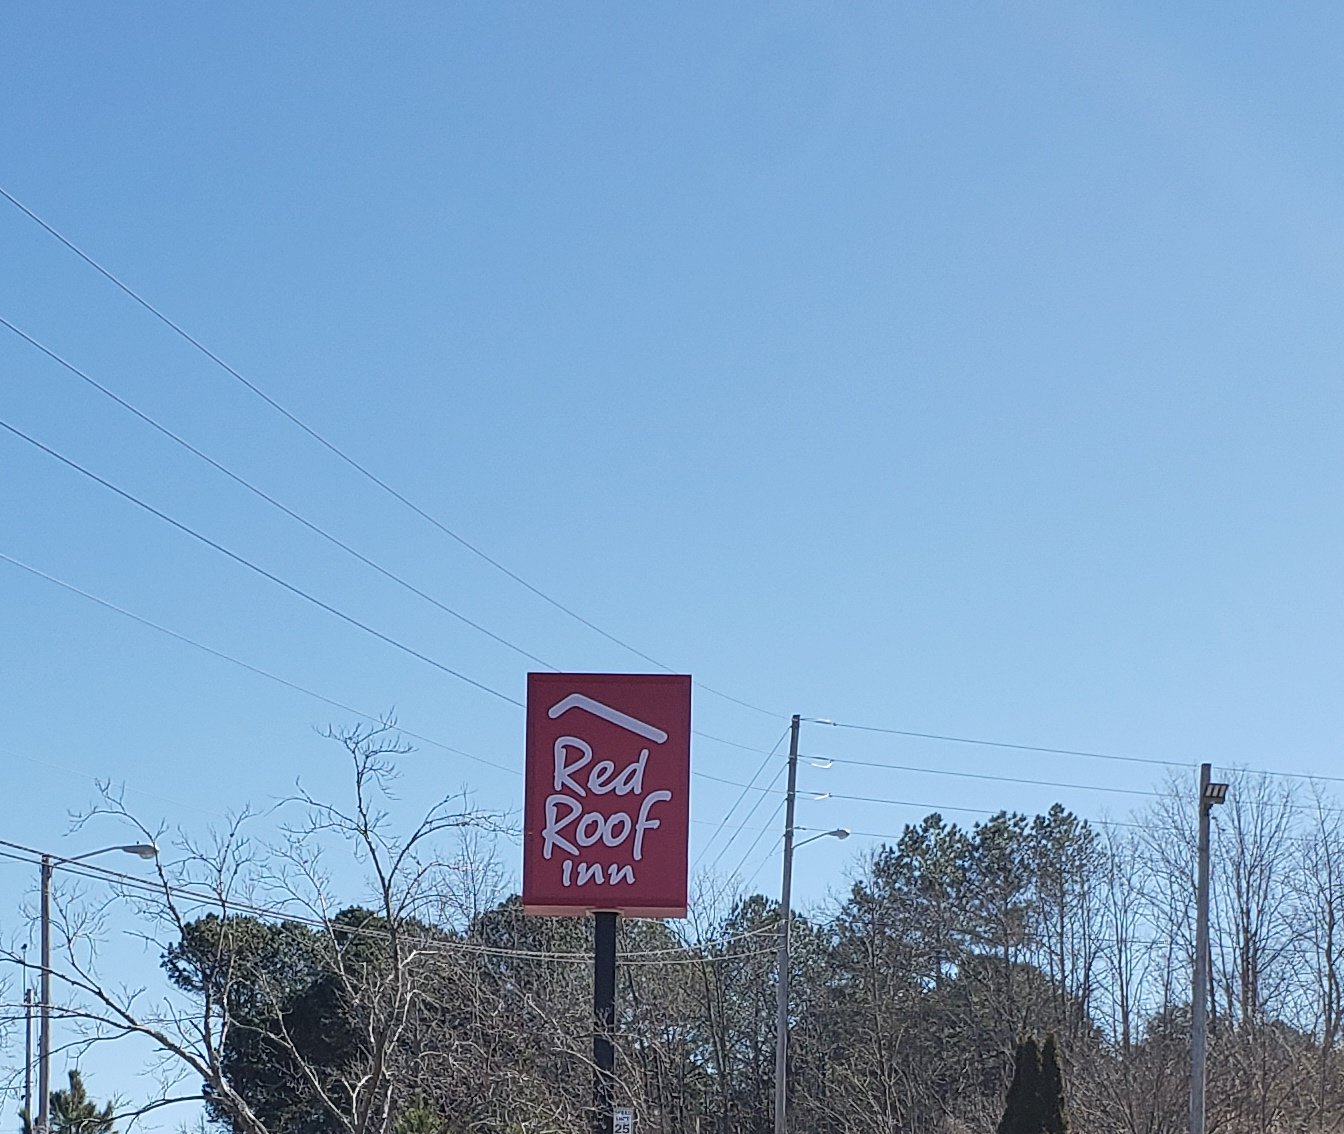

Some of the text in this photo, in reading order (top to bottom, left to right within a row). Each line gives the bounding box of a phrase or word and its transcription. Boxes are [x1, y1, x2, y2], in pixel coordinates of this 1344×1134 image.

[554, 735, 649, 797] Red
[541, 790, 672, 861] Roof
[614, 1123, 630, 1134] 25
